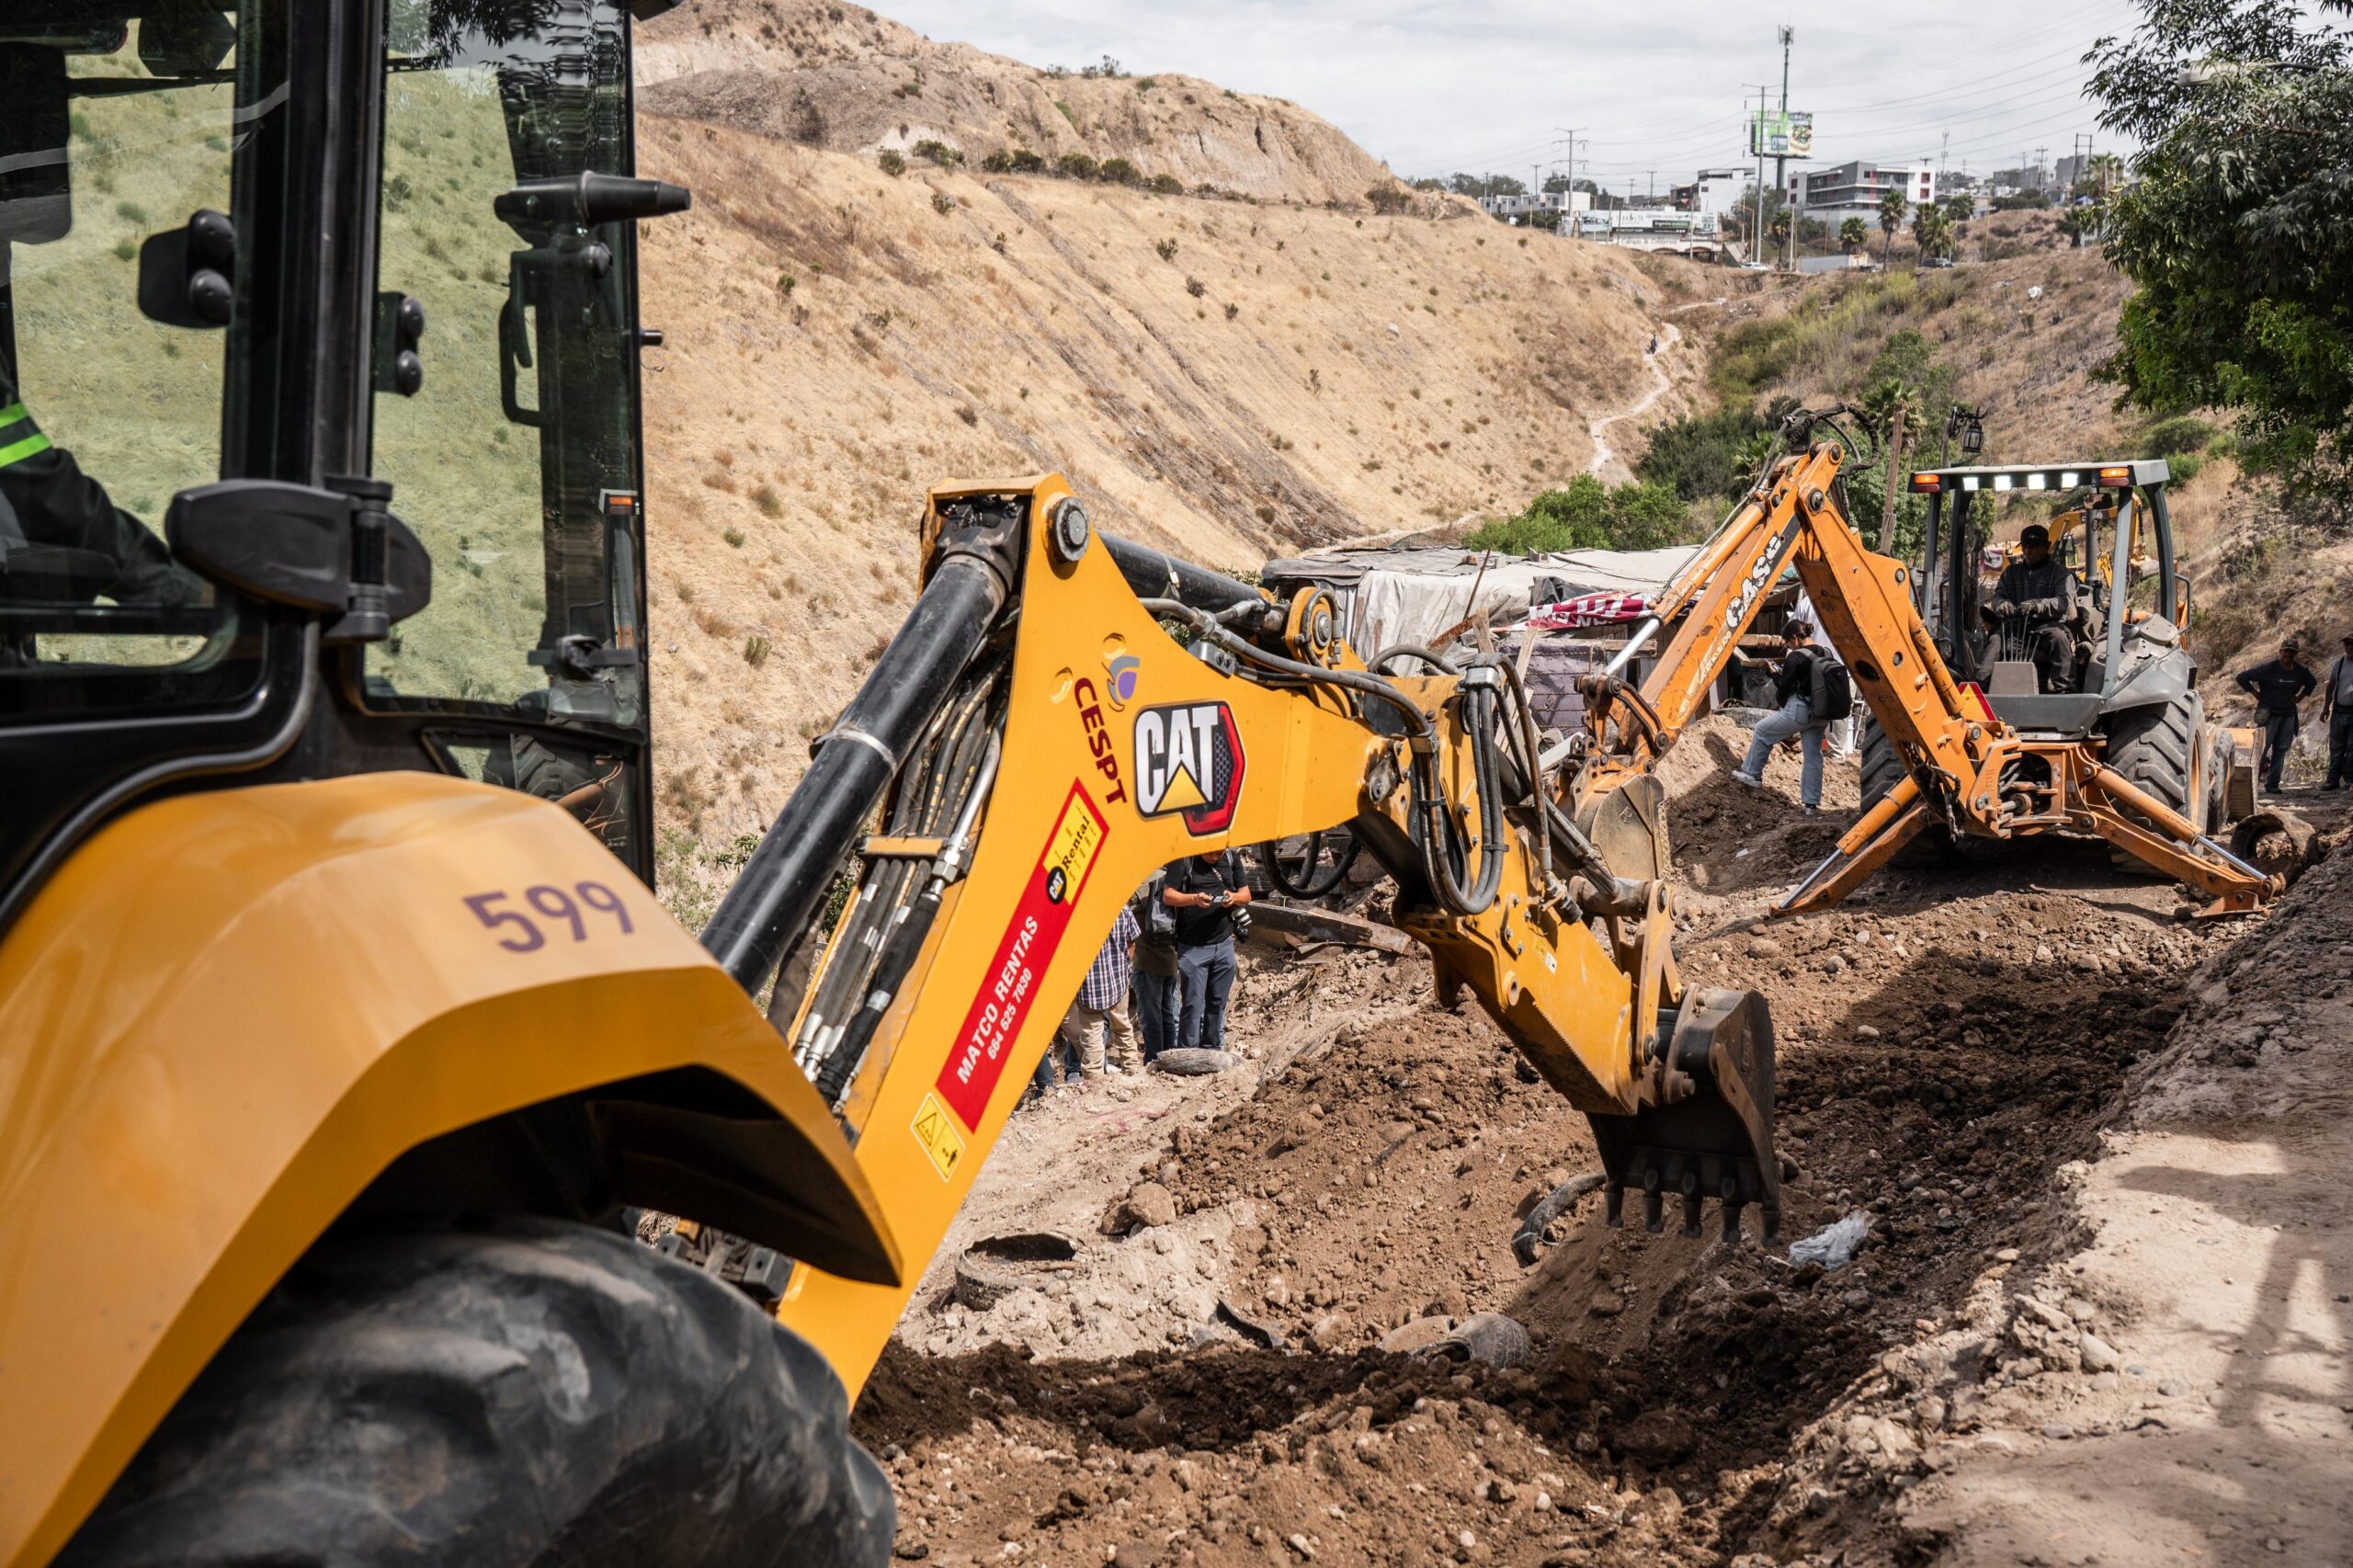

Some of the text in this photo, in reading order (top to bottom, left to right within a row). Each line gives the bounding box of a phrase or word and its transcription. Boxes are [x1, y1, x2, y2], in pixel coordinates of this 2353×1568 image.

[1725, 536, 1781, 628] CASE
[1074, 677, 1127, 804] CESPT
[1134, 705, 1219, 814] CAT
[1048, 814, 1090, 900] CAT Rental
[461, 881, 634, 953] 599
[957, 915, 1038, 1085] MATCO RENTAS
[987, 968, 1032, 1060] 664 625 7030
